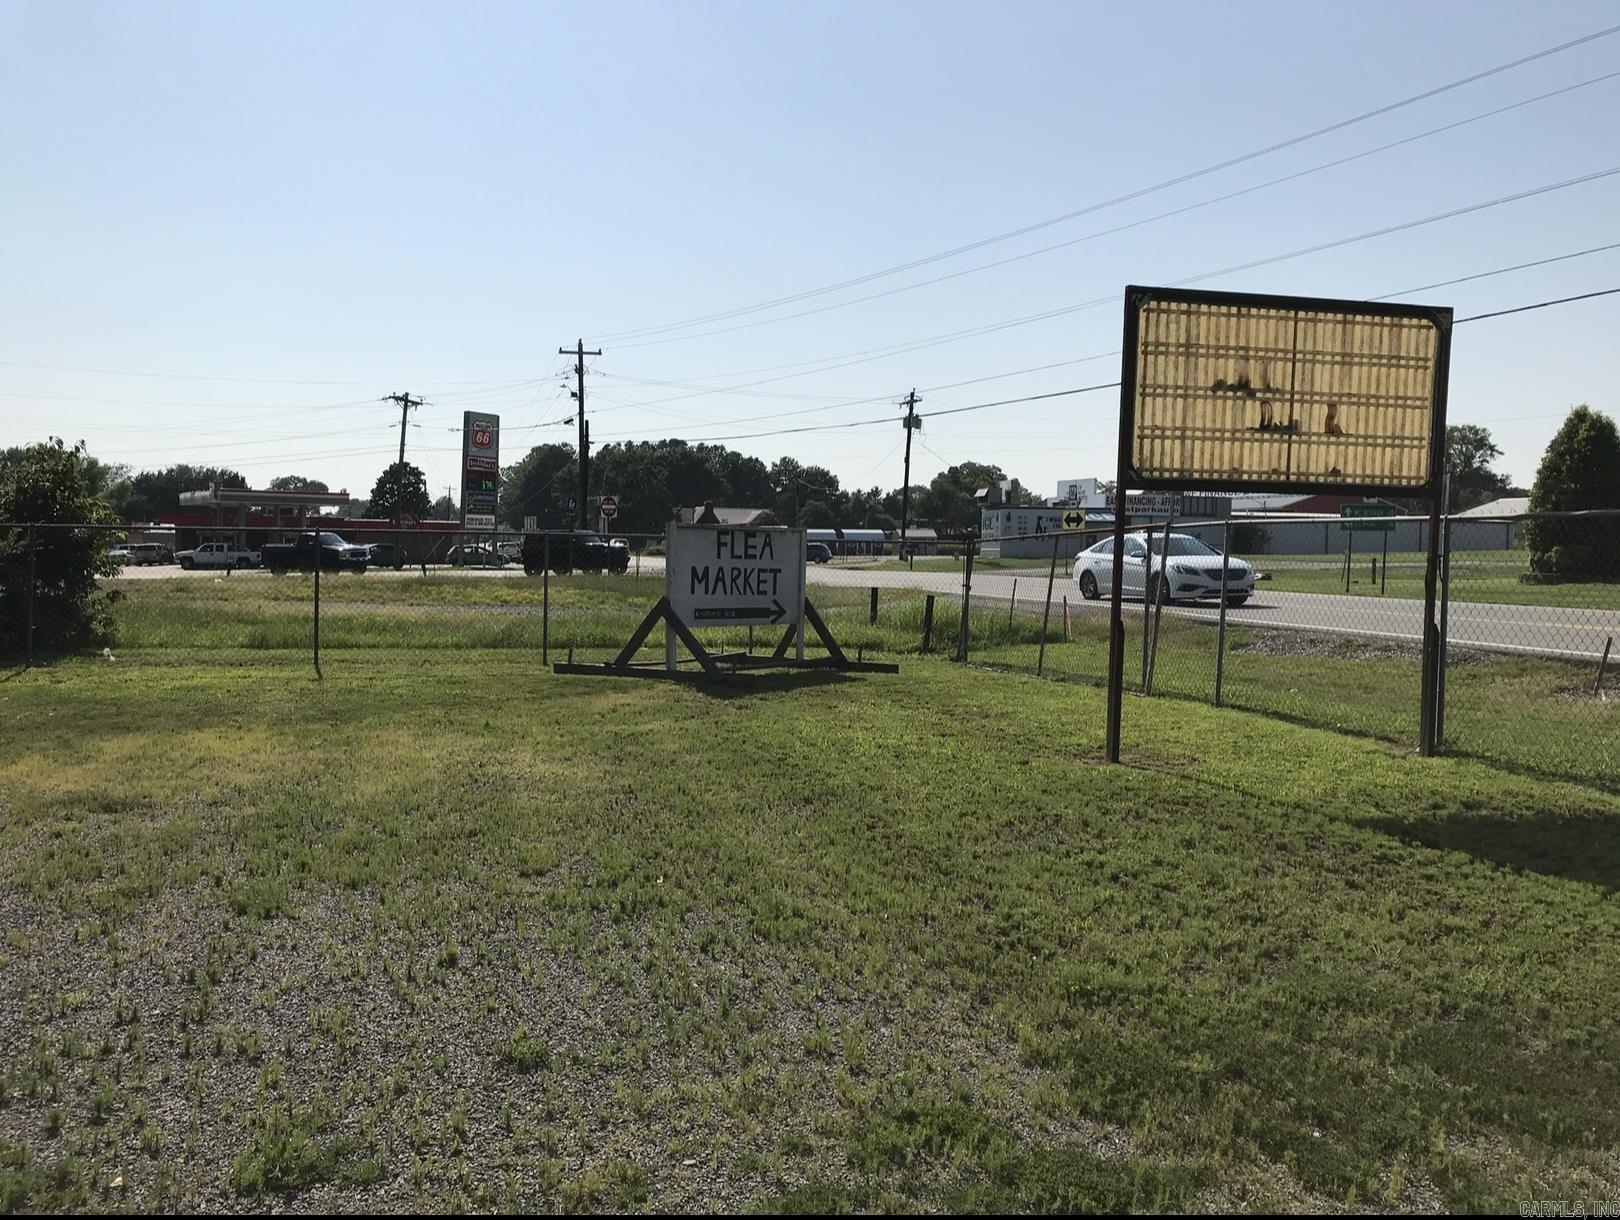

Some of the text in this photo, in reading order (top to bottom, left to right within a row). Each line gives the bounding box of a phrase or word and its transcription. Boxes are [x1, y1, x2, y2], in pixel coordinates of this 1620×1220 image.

[476, 432, 489, 444] 66
[1126, 496, 1156, 506] INANCING
[716, 530, 774, 560] FLEA
[690, 566, 782, 596] MARKET
